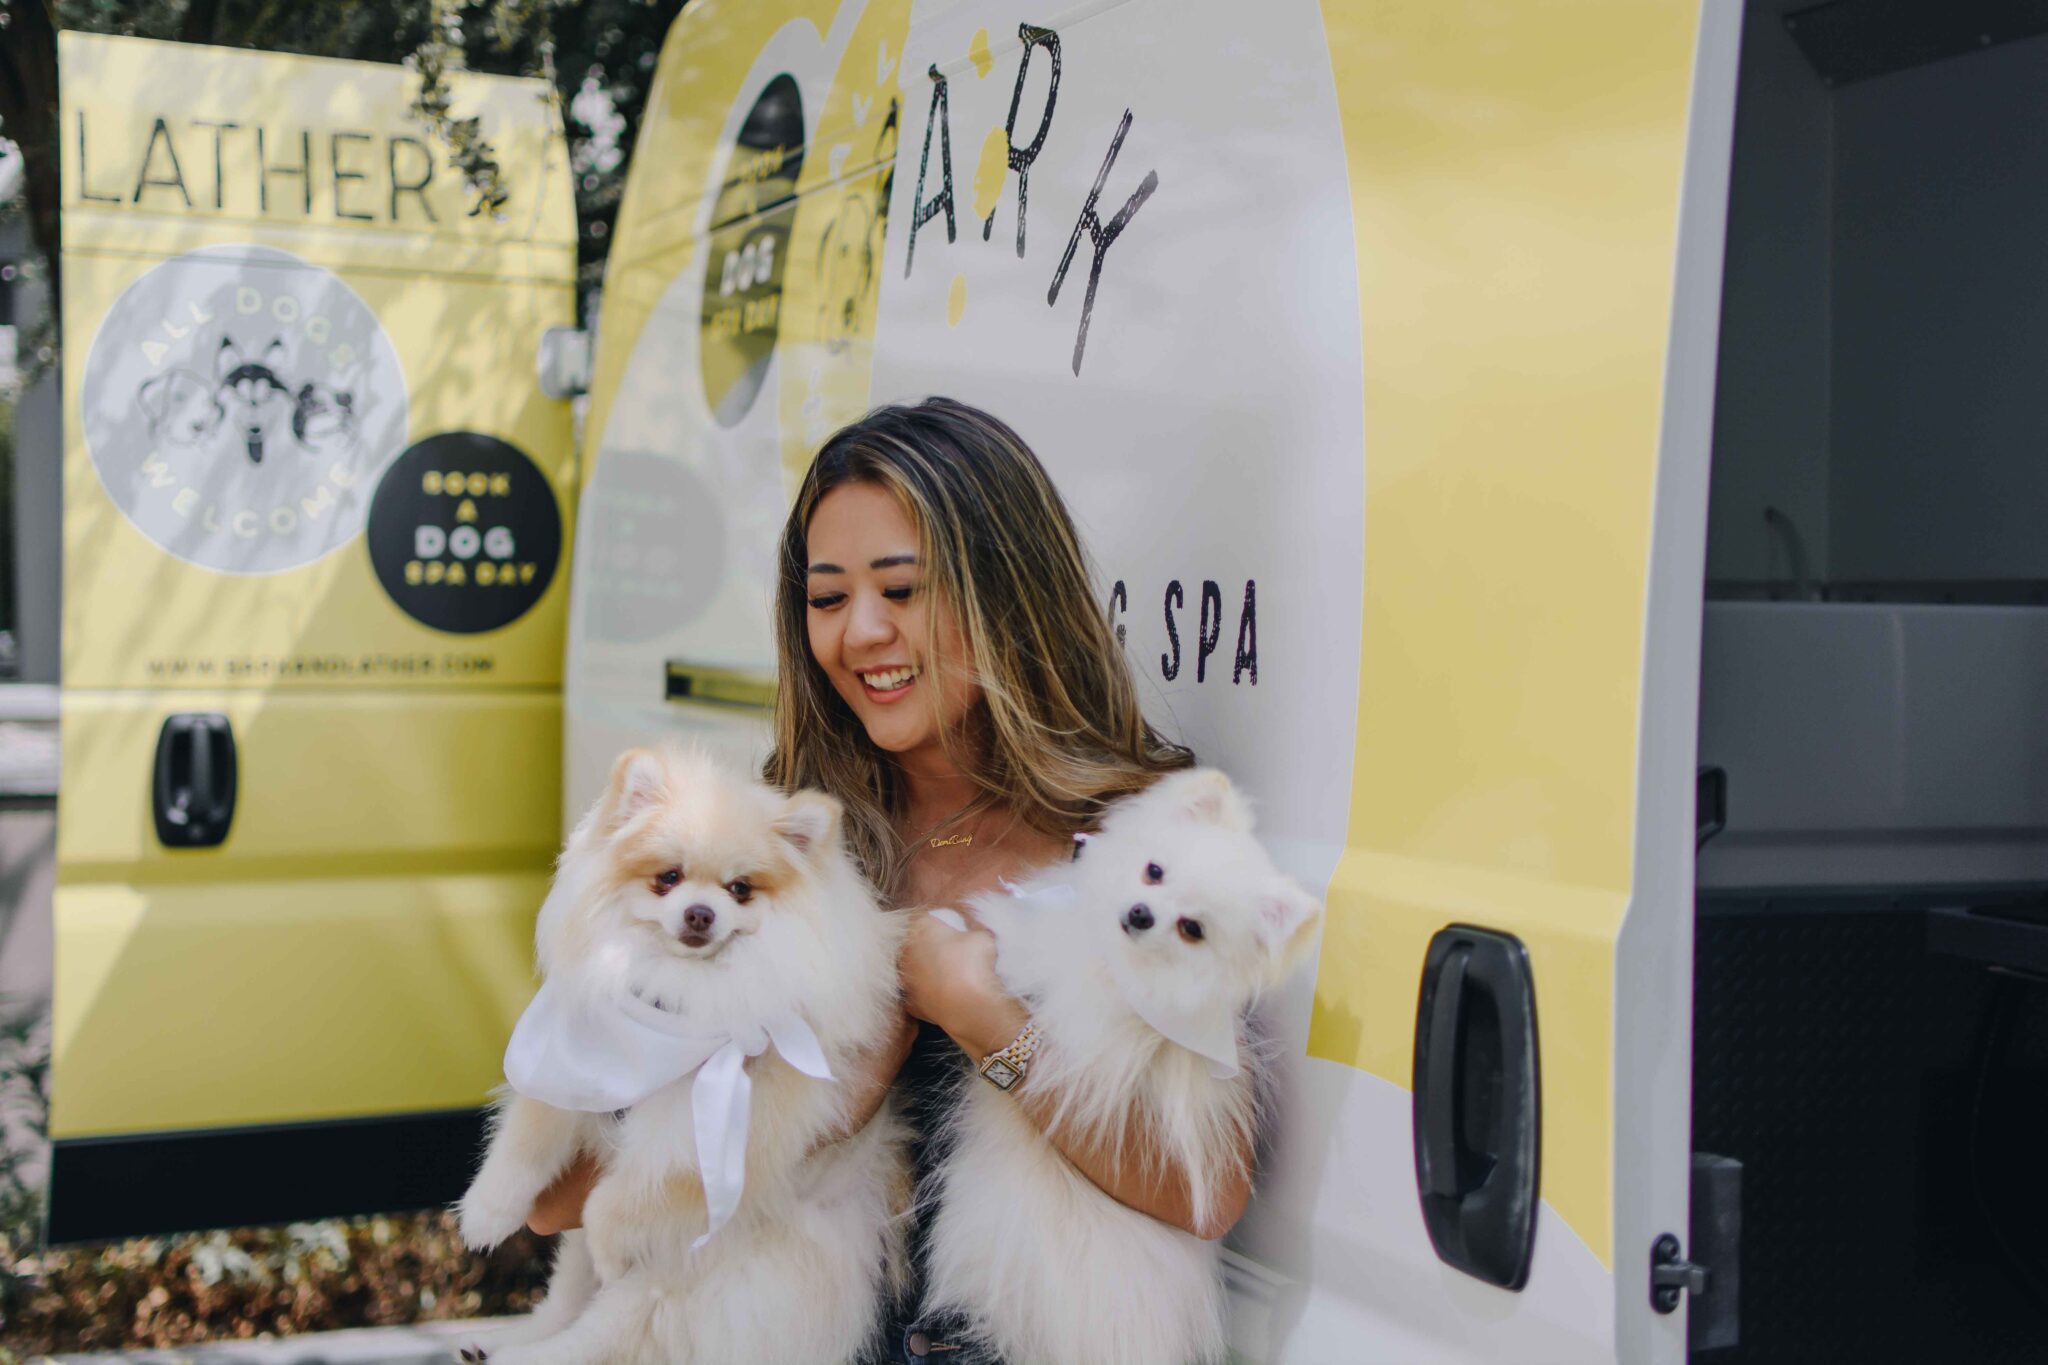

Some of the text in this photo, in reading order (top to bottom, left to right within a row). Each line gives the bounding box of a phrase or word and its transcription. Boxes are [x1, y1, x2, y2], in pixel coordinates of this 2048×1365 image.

[78, 110, 438, 222] LATHER
[141, 286, 356, 370] ALL DOGS
[141, 450, 356, 539] WELCOME
[422, 470, 511, 498] BOOK
[455, 499, 479, 523] A
[414, 524, 516, 560] DOG
[404, 560, 538, 587] SPA DAY
[1161, 579, 1258, 686] SPA
